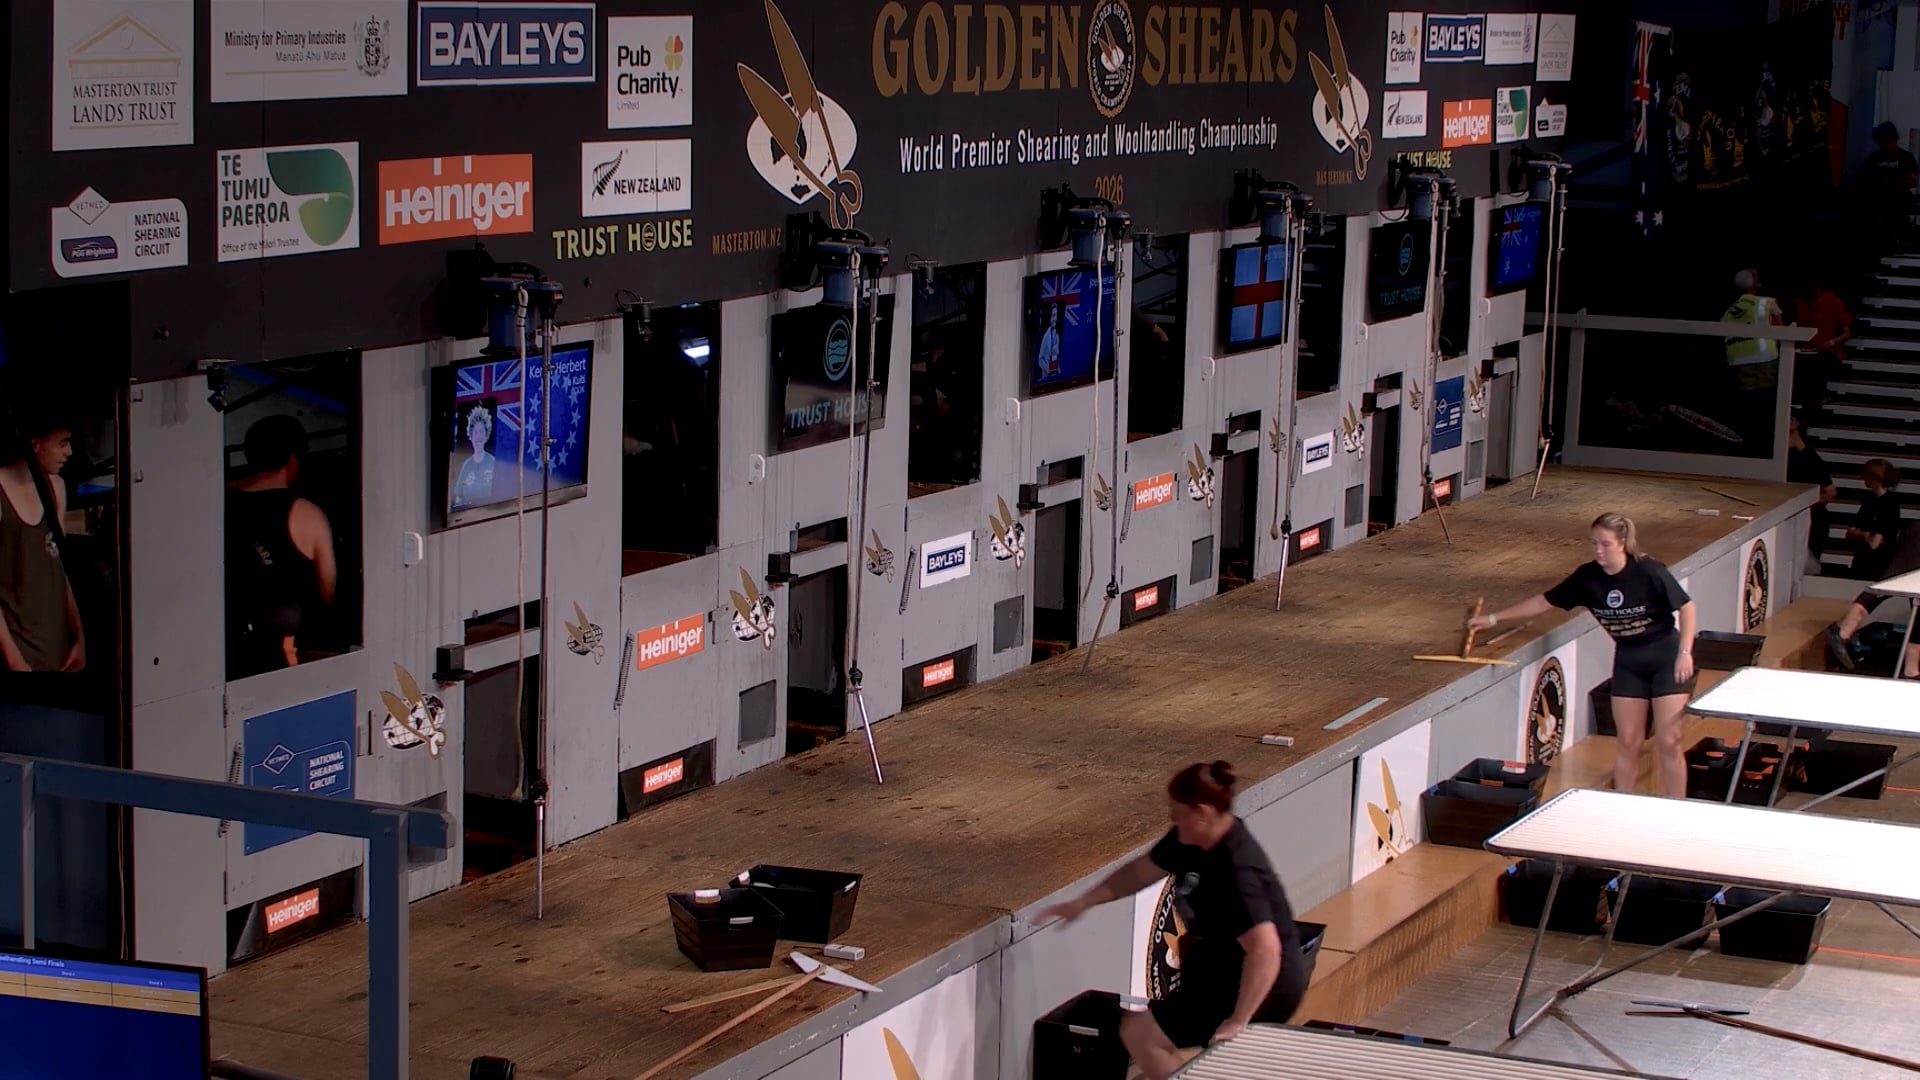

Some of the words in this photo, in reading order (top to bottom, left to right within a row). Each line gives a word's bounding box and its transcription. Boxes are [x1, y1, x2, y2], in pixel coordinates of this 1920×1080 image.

[1092, 4, 1112, 45] GOLDEN
[224, 31, 260, 49] Ministry
[262, 31, 273, 46] for
[276, 31, 306, 48] Primary
[308, 30, 346, 45] Industries
[429, 20, 586, 67] BAYLEYS
[872, 0, 1080, 97] GOLDEN
[1141, 3, 1298, 86] SHEARS
[1391, 30, 1406, 46] Pub
[1430, 24, 1480, 52] BAYLEYS
[617, 45, 651, 68] Pub
[72, 82, 141, 99] MASTERTON
[143, 82, 176, 96] TRUST
[617, 72, 680, 99] Charity
[73, 104, 124, 124] LANDS
[128, 102, 177, 121] TRUST
[1444, 102, 1490, 142] Heiniger
[900, 134, 944, 174] World
[951, 136, 1012, 169] Premier
[1017, 128, 1080, 166] Shearing
[1085, 126, 1108, 158] and
[1114, 120, 1195, 156] Woolhandling
[1200, 116, 1278, 152] Championship
[222, 154, 242, 177] TE
[222, 177, 270, 200] TUMU
[385, 156, 530, 230] Heiniger
[614, 178, 636, 196] NEW
[638, 176, 682, 194] ZEALAND
[1095, 174, 1124, 206] 2026
[134, 210, 180, 226] NATIONAL
[222, 202, 290, 228] PAEROA
[134, 227, 181, 242] SHEARING
[552, 224, 618, 260] TRUST
[627, 218, 694, 252] HOUSE
[712, 227, 782, 255] MASTERTON.NZ
[135, 242, 170, 258] CIRCUIT
[240, 242, 247, 252] of
[248, 241, 258, 250] the
[556, 358, 586, 375] Herbert
[790, 402, 831, 429] TRUST
[1136, 476, 1173, 504] Heiniger
[928, 549, 964, 571] BAYLEYS
[1616, 605, 1647, 616] HOUSE
[640, 620, 703, 662] Heiniger
[309, 750, 344, 768] NATIONAL
[309, 761, 345, 780] SHEARING
[310, 774, 337, 790] CIRCUIT
[644, 764, 684, 788] Heiniger
[268, 895, 320, 927] Heiniger
